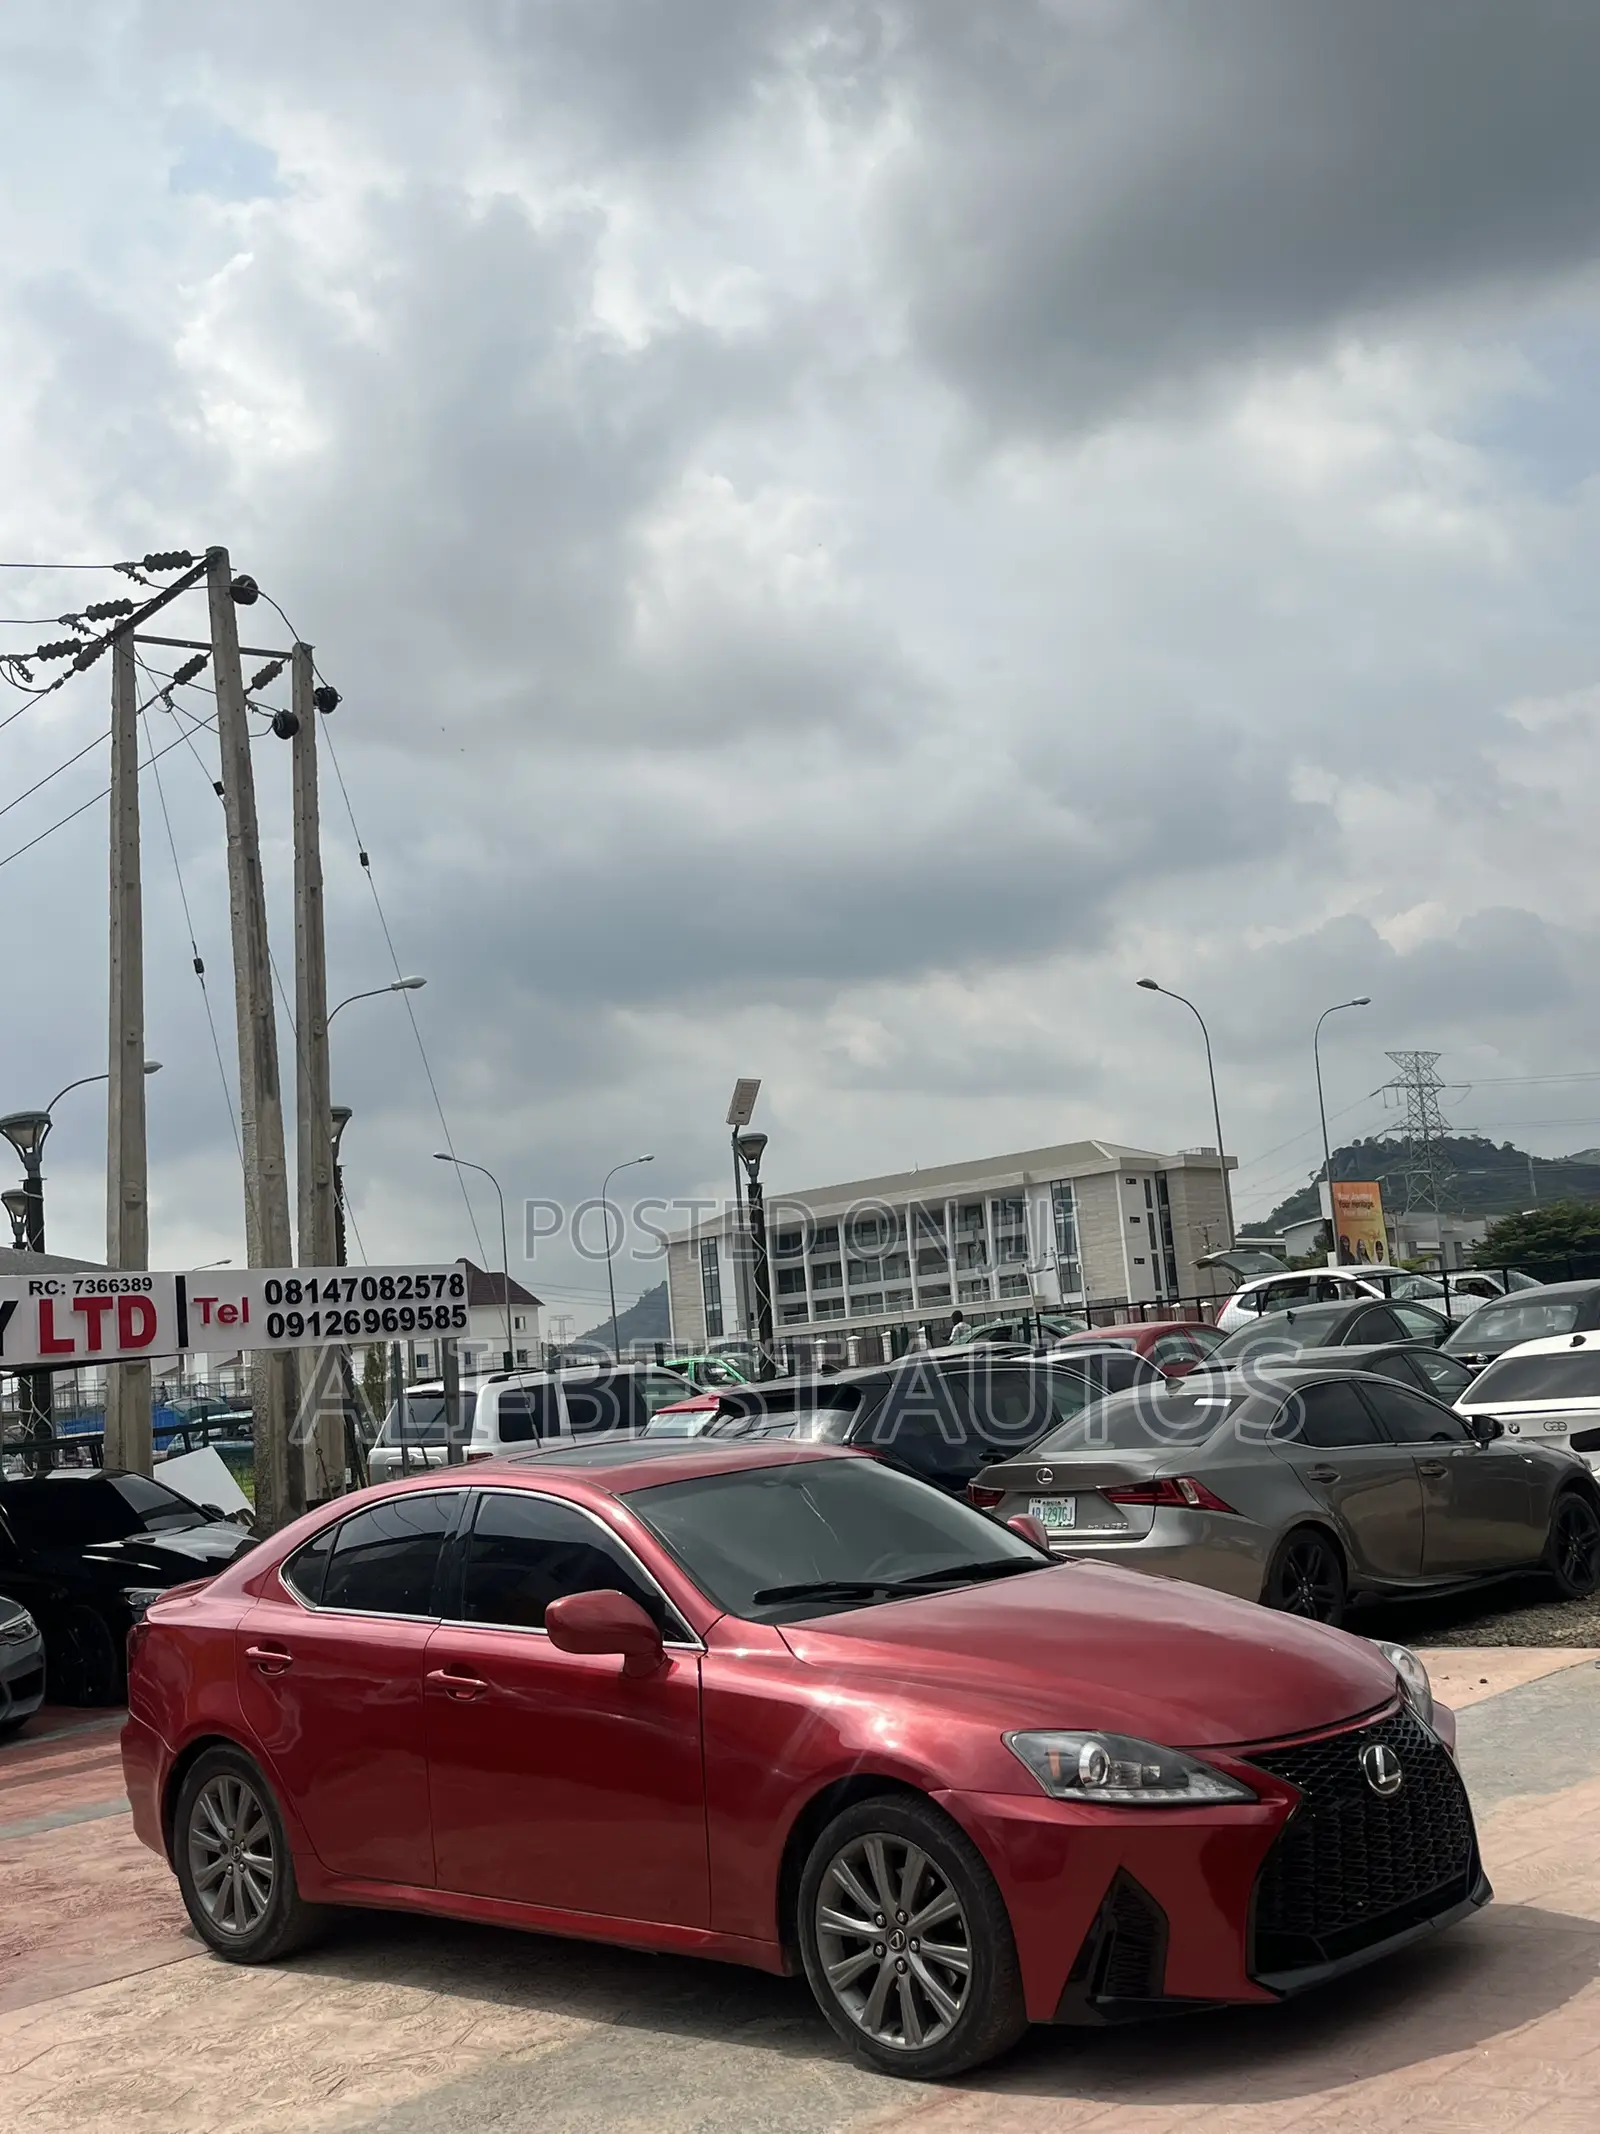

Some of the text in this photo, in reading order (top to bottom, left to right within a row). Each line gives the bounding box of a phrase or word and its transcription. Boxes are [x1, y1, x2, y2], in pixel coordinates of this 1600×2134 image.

[28, 1276, 153, 1296] RC: 7366389
[264, 1272, 465, 1305] 08147082578
[38, 1294, 158, 1354] LTD
[192, 1296, 249, 1325] Tel
[266, 1304, 467, 1339] 09126969585
